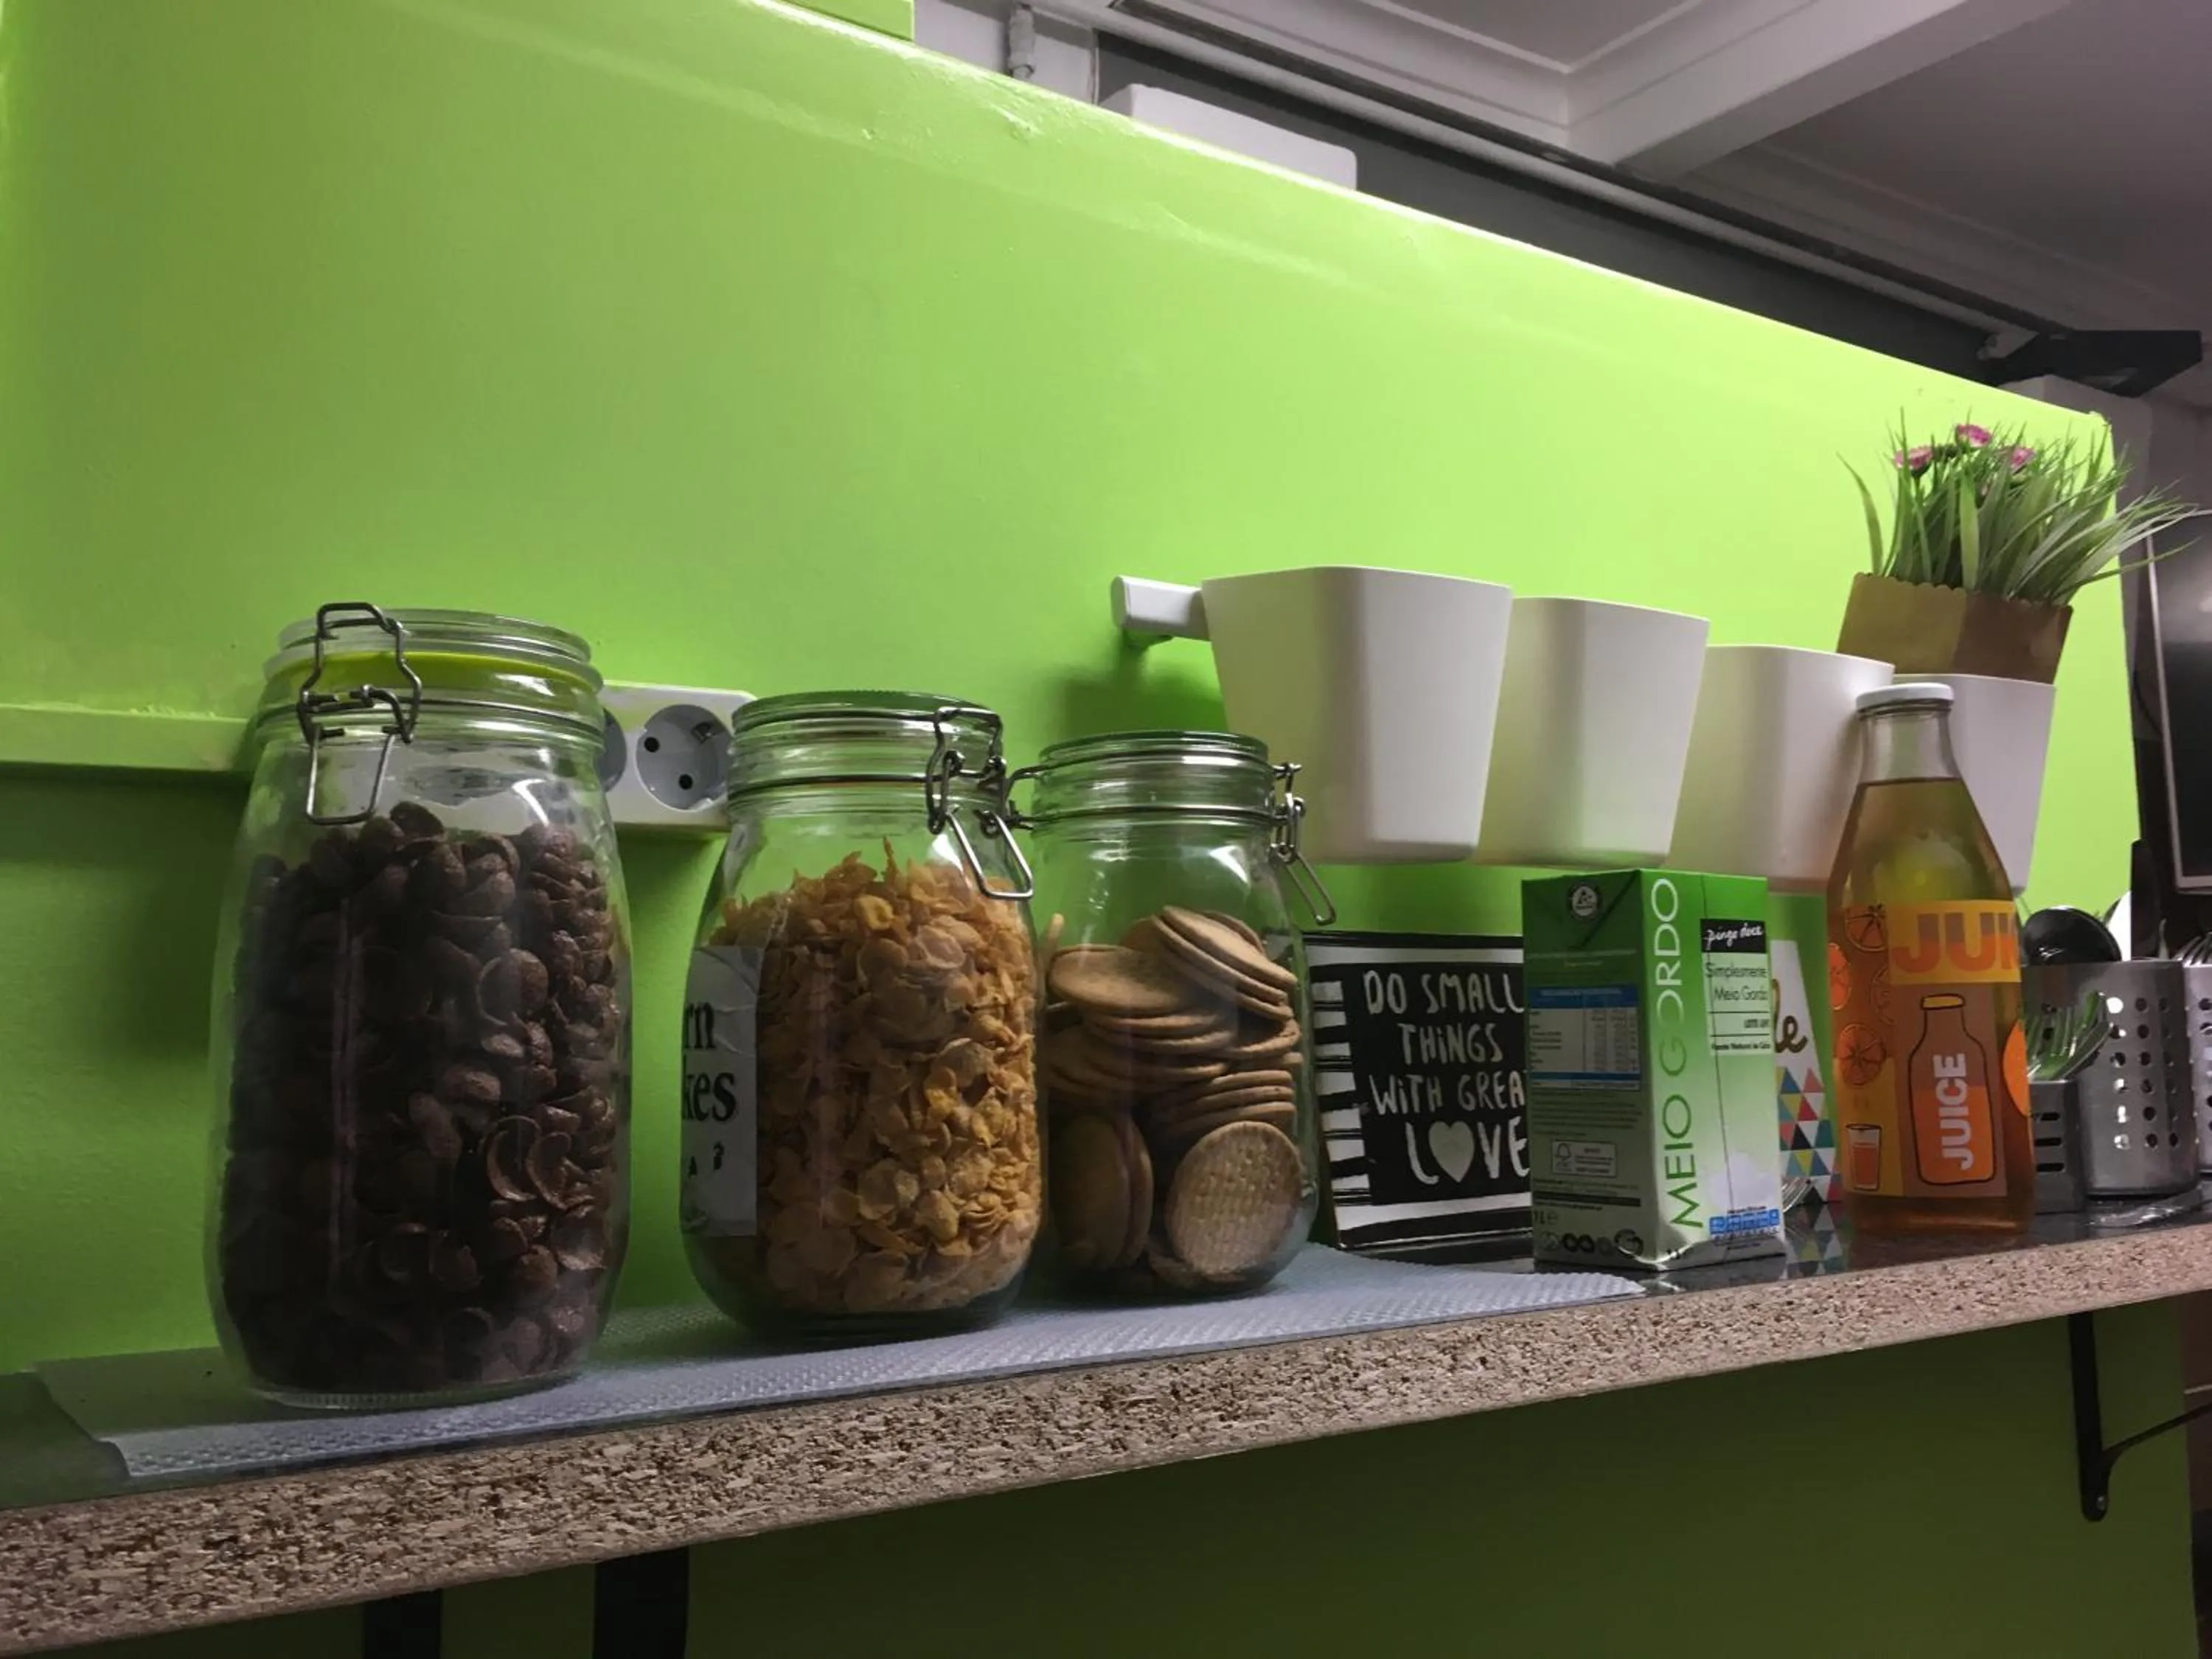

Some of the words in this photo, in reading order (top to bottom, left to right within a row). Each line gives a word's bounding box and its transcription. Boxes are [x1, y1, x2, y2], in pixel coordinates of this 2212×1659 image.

[1891, 912, 2016, 973] JUI
[1363, 969, 1407, 1015] DO
[1421, 972, 1525, 1014] SMALL
[1457, 1070, 1526, 1111] GREA
[1932, 1053, 1974, 1170] JUICE
[1662, 1094, 1703, 1228] MEIO
